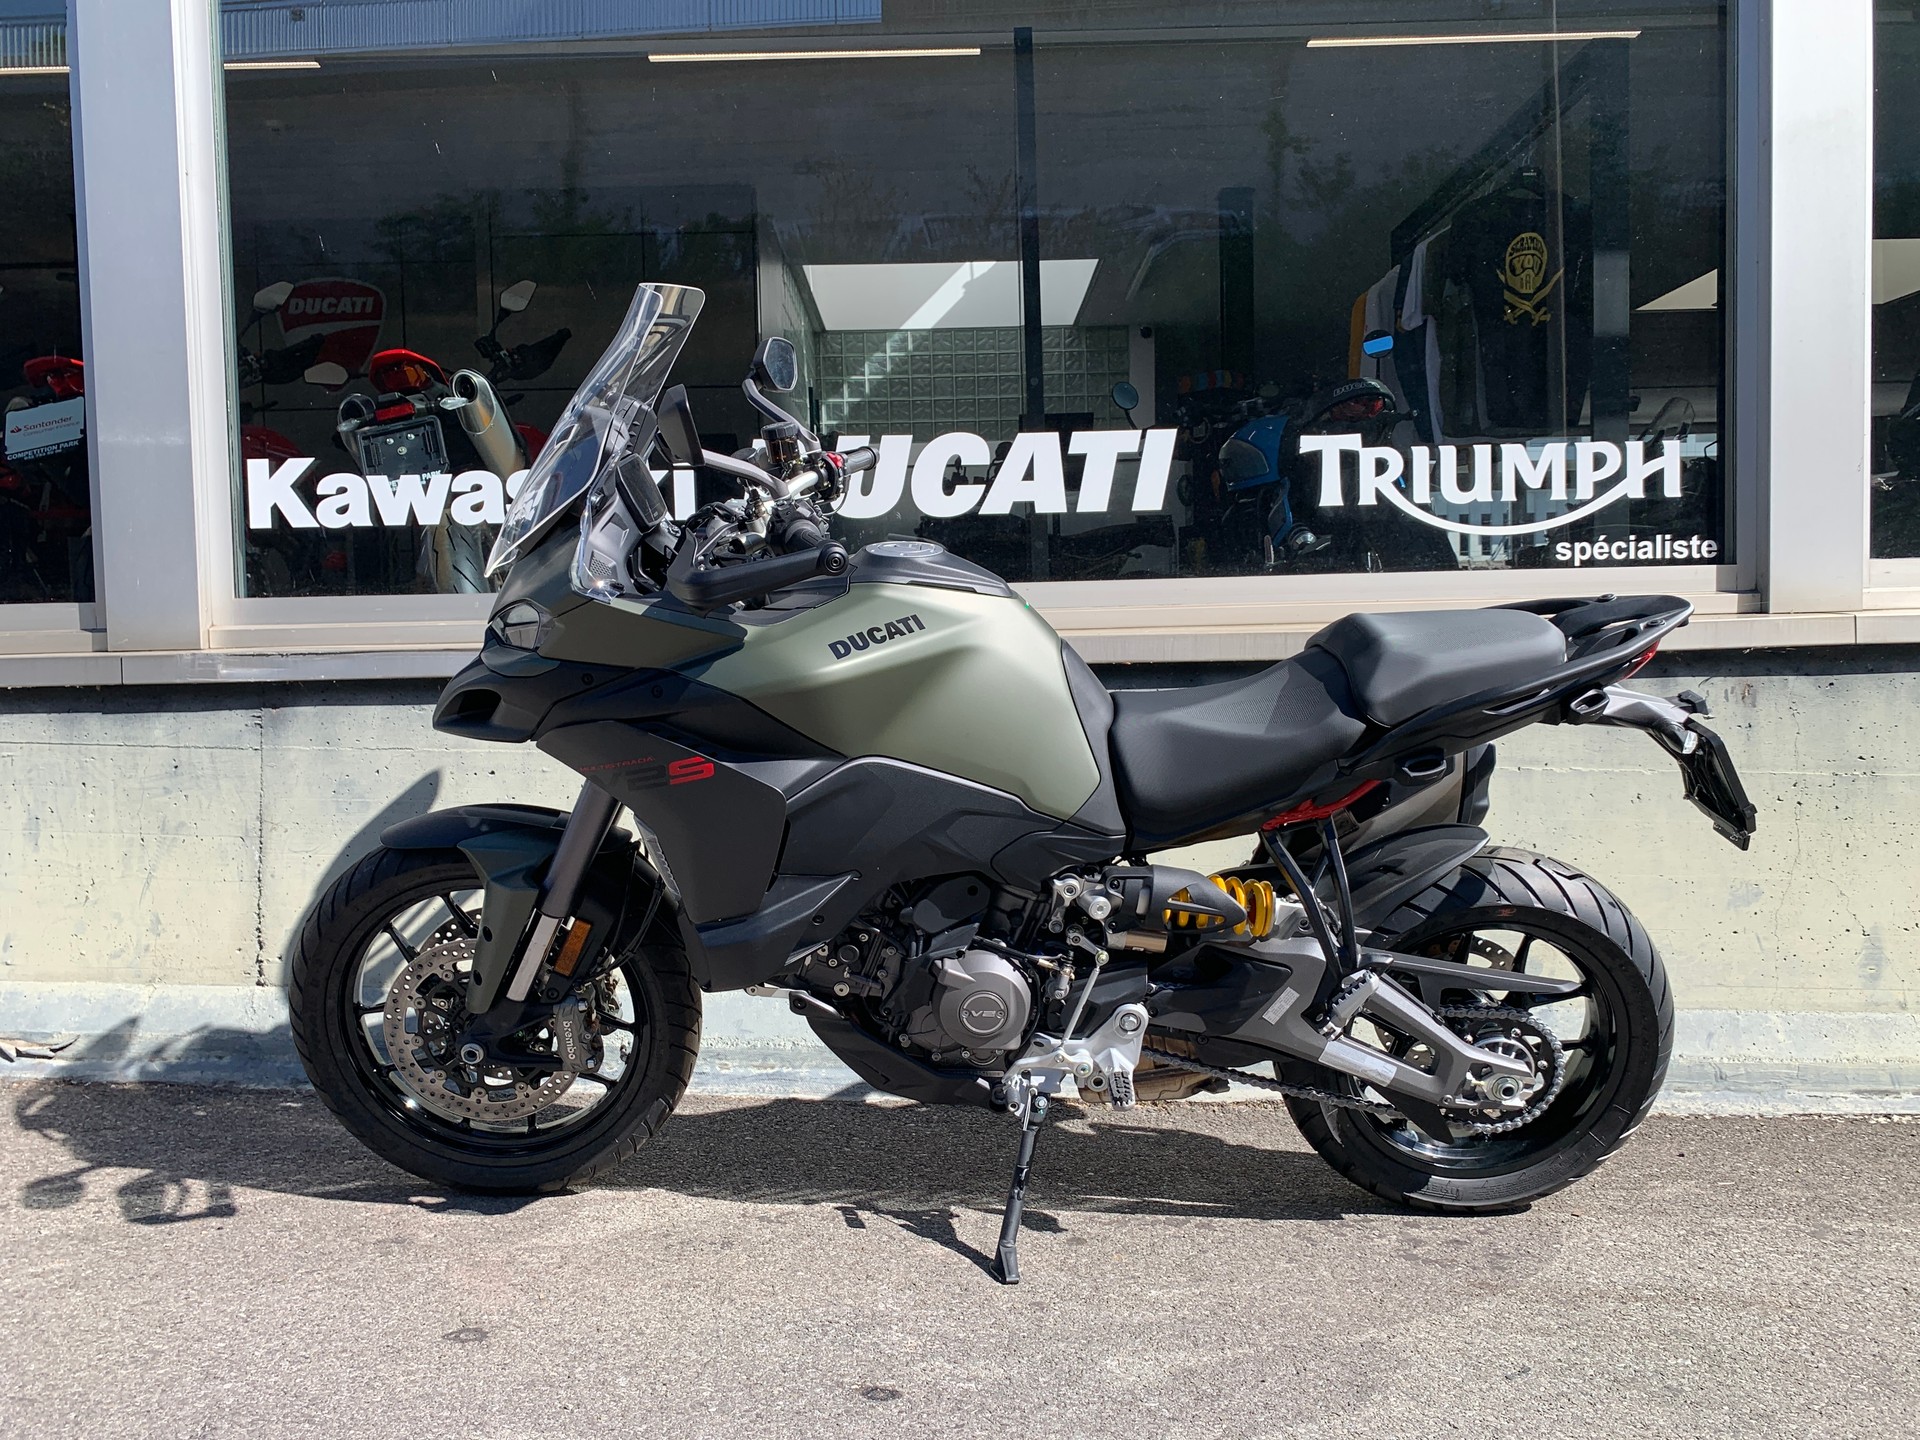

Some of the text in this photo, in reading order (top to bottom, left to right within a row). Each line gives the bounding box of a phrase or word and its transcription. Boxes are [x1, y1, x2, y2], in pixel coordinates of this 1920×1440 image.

[288, 297, 374, 315] DUCATI
[23, 416, 73, 432] Santander
[7, 444, 58, 460] COMPETITION
[59, 440, 79, 449] PARK
[743, 429, 1178, 519] UCATI
[1300, 434, 1682, 536] TRIUMPH
[1555, 534, 1717, 564] spécialiste
[828, 614, 926, 660] DUCATI
[562, 1020, 577, 1060] brembo
